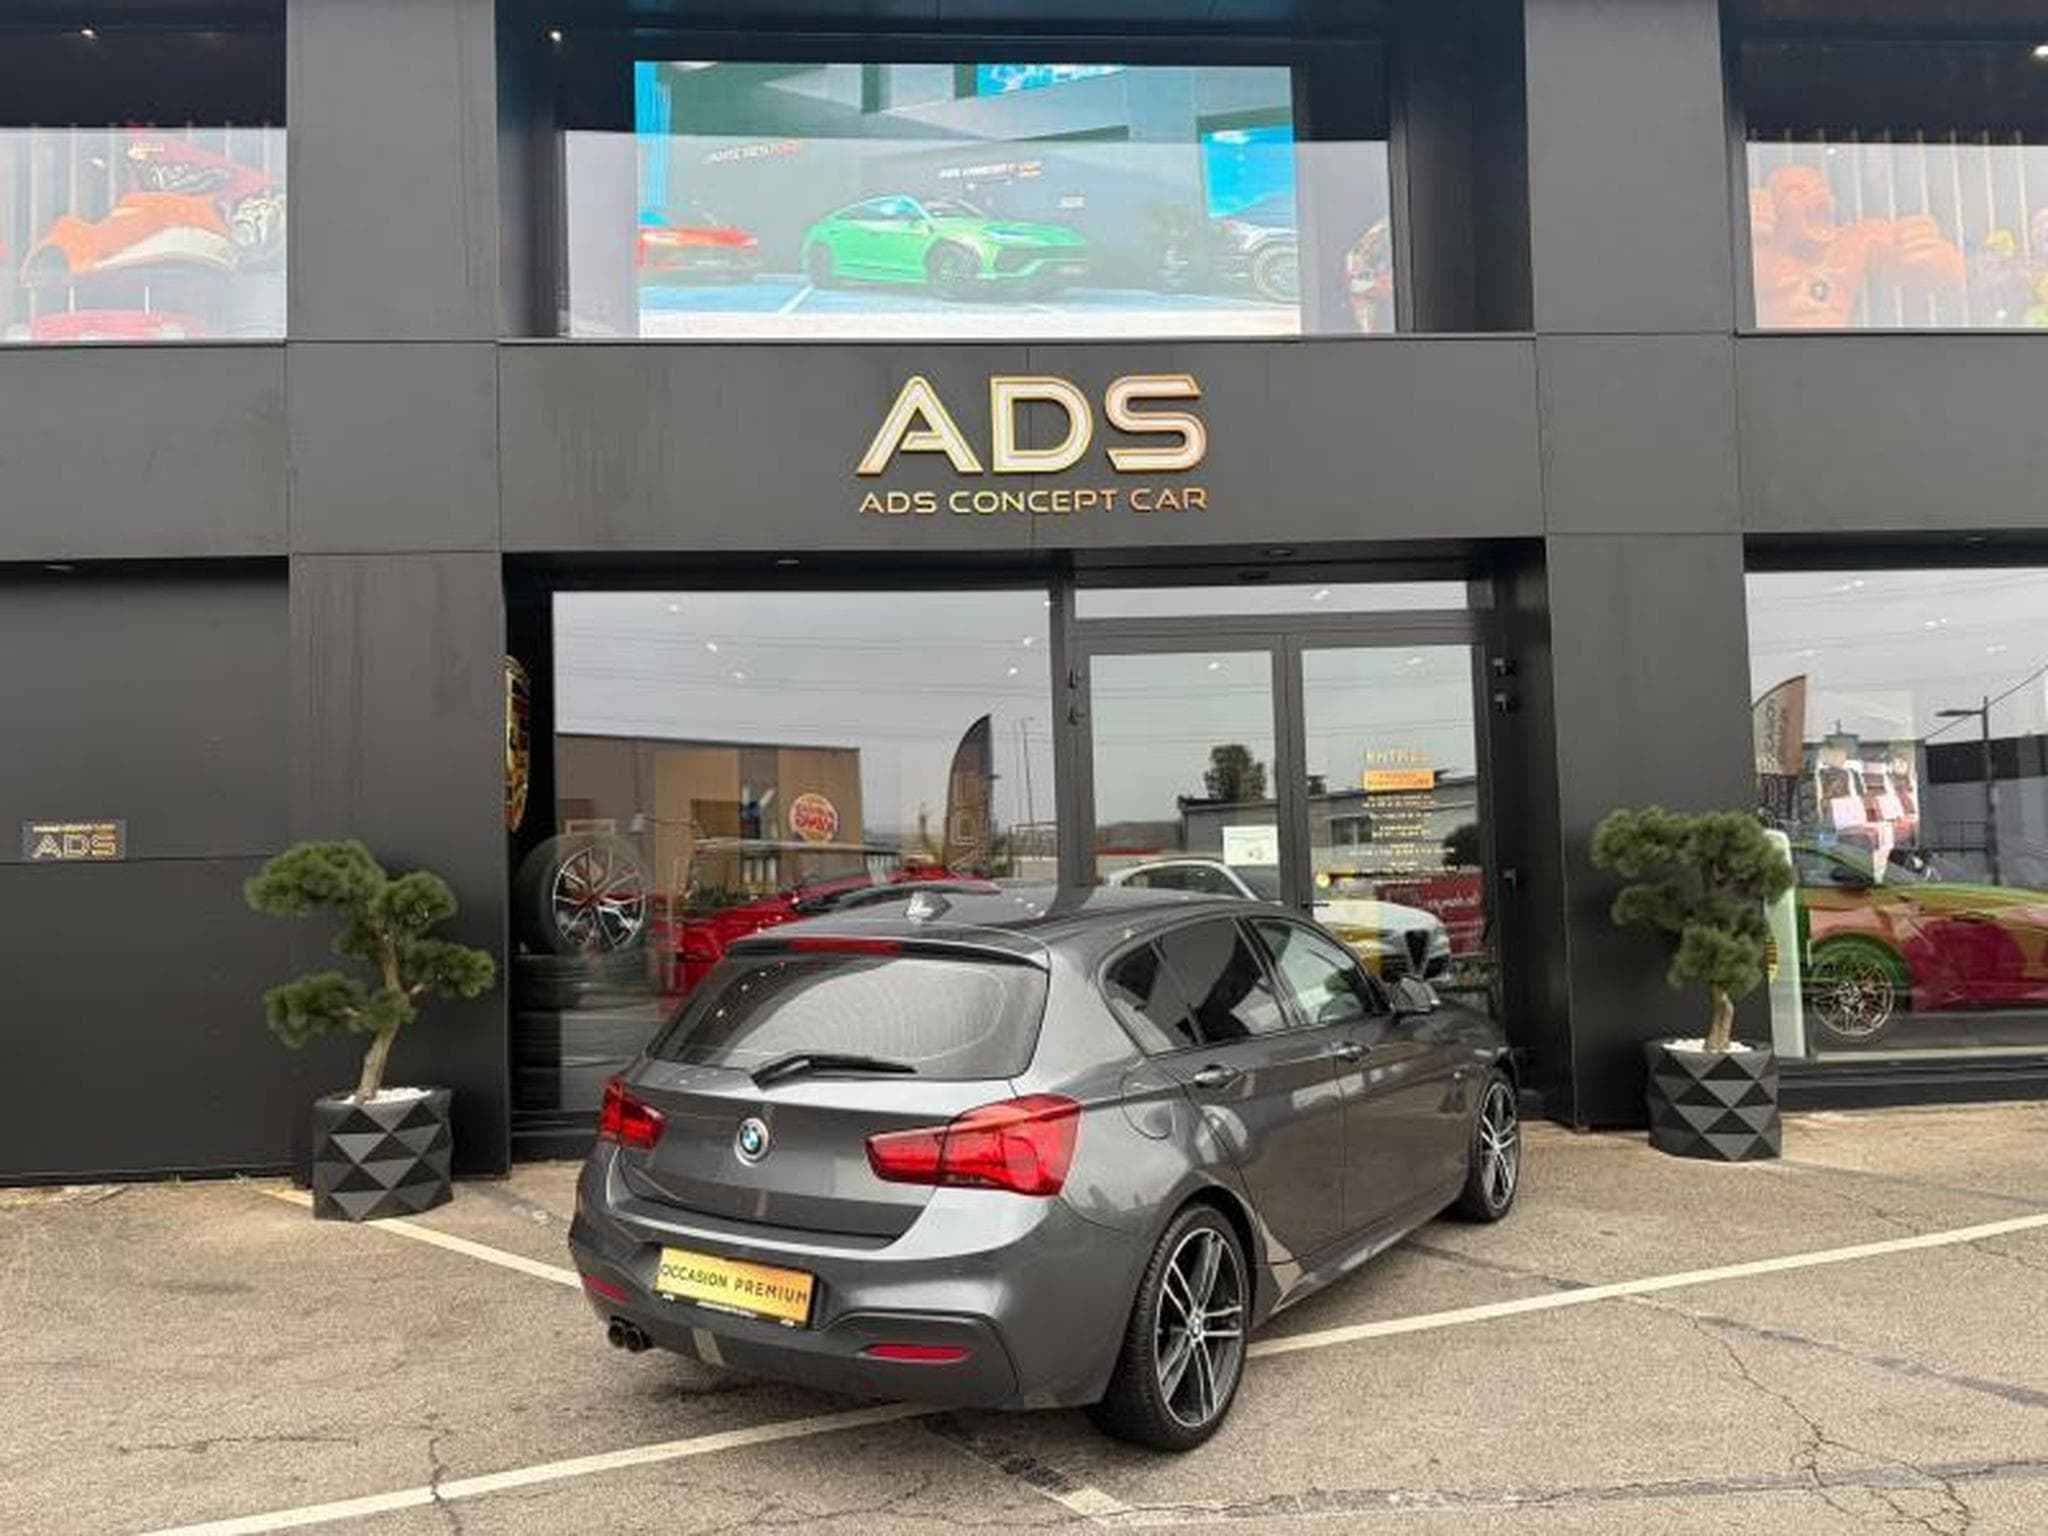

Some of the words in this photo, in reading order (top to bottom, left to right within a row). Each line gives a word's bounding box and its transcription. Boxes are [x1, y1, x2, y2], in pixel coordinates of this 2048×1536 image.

[856, 374, 1207, 476] ADS
[859, 492, 937, 514] ADS
[949, 490, 1117, 513] CONCEPT
[1129, 488, 1207, 512] CAR
[32, 834, 117, 859] ADS
[660, 1263, 728, 1289] OCCASION
[734, 1277, 808, 1304] PREMIUM
